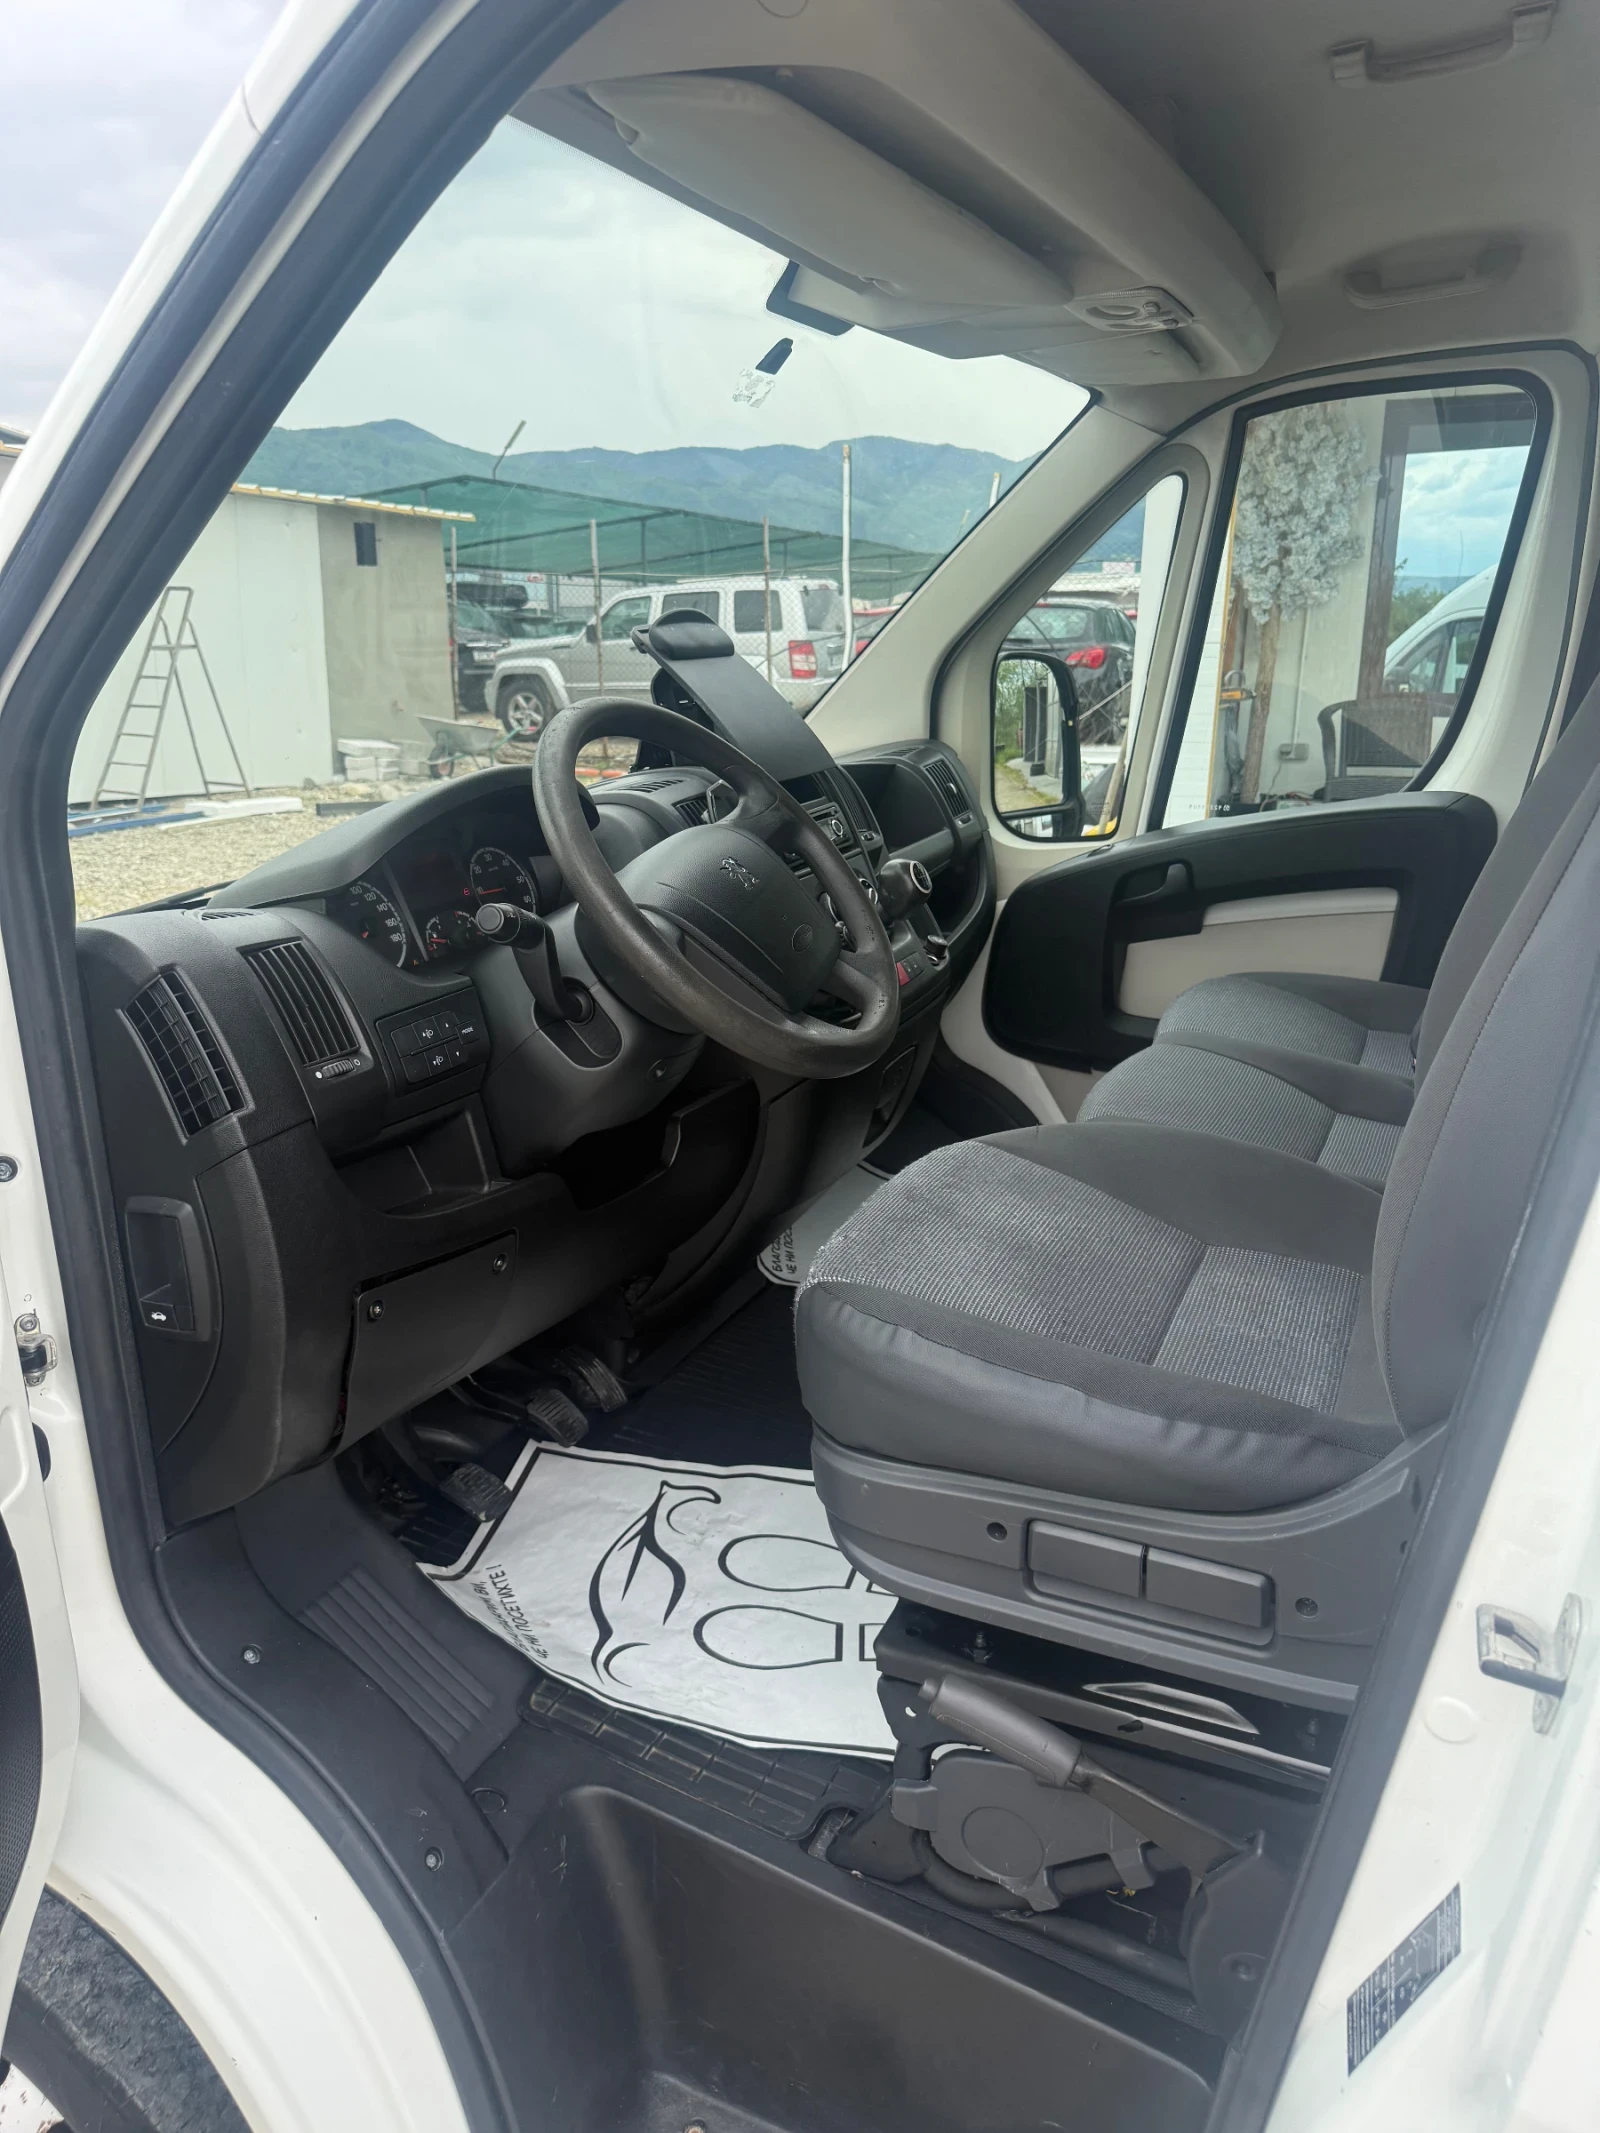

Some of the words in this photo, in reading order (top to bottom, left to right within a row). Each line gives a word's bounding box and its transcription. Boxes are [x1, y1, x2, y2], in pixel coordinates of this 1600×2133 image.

[349, 885, 362, 895] 100
[364, 892, 377, 901] 120
[376, 902, 388, 912] 140
[385, 917, 398, 927] 160
